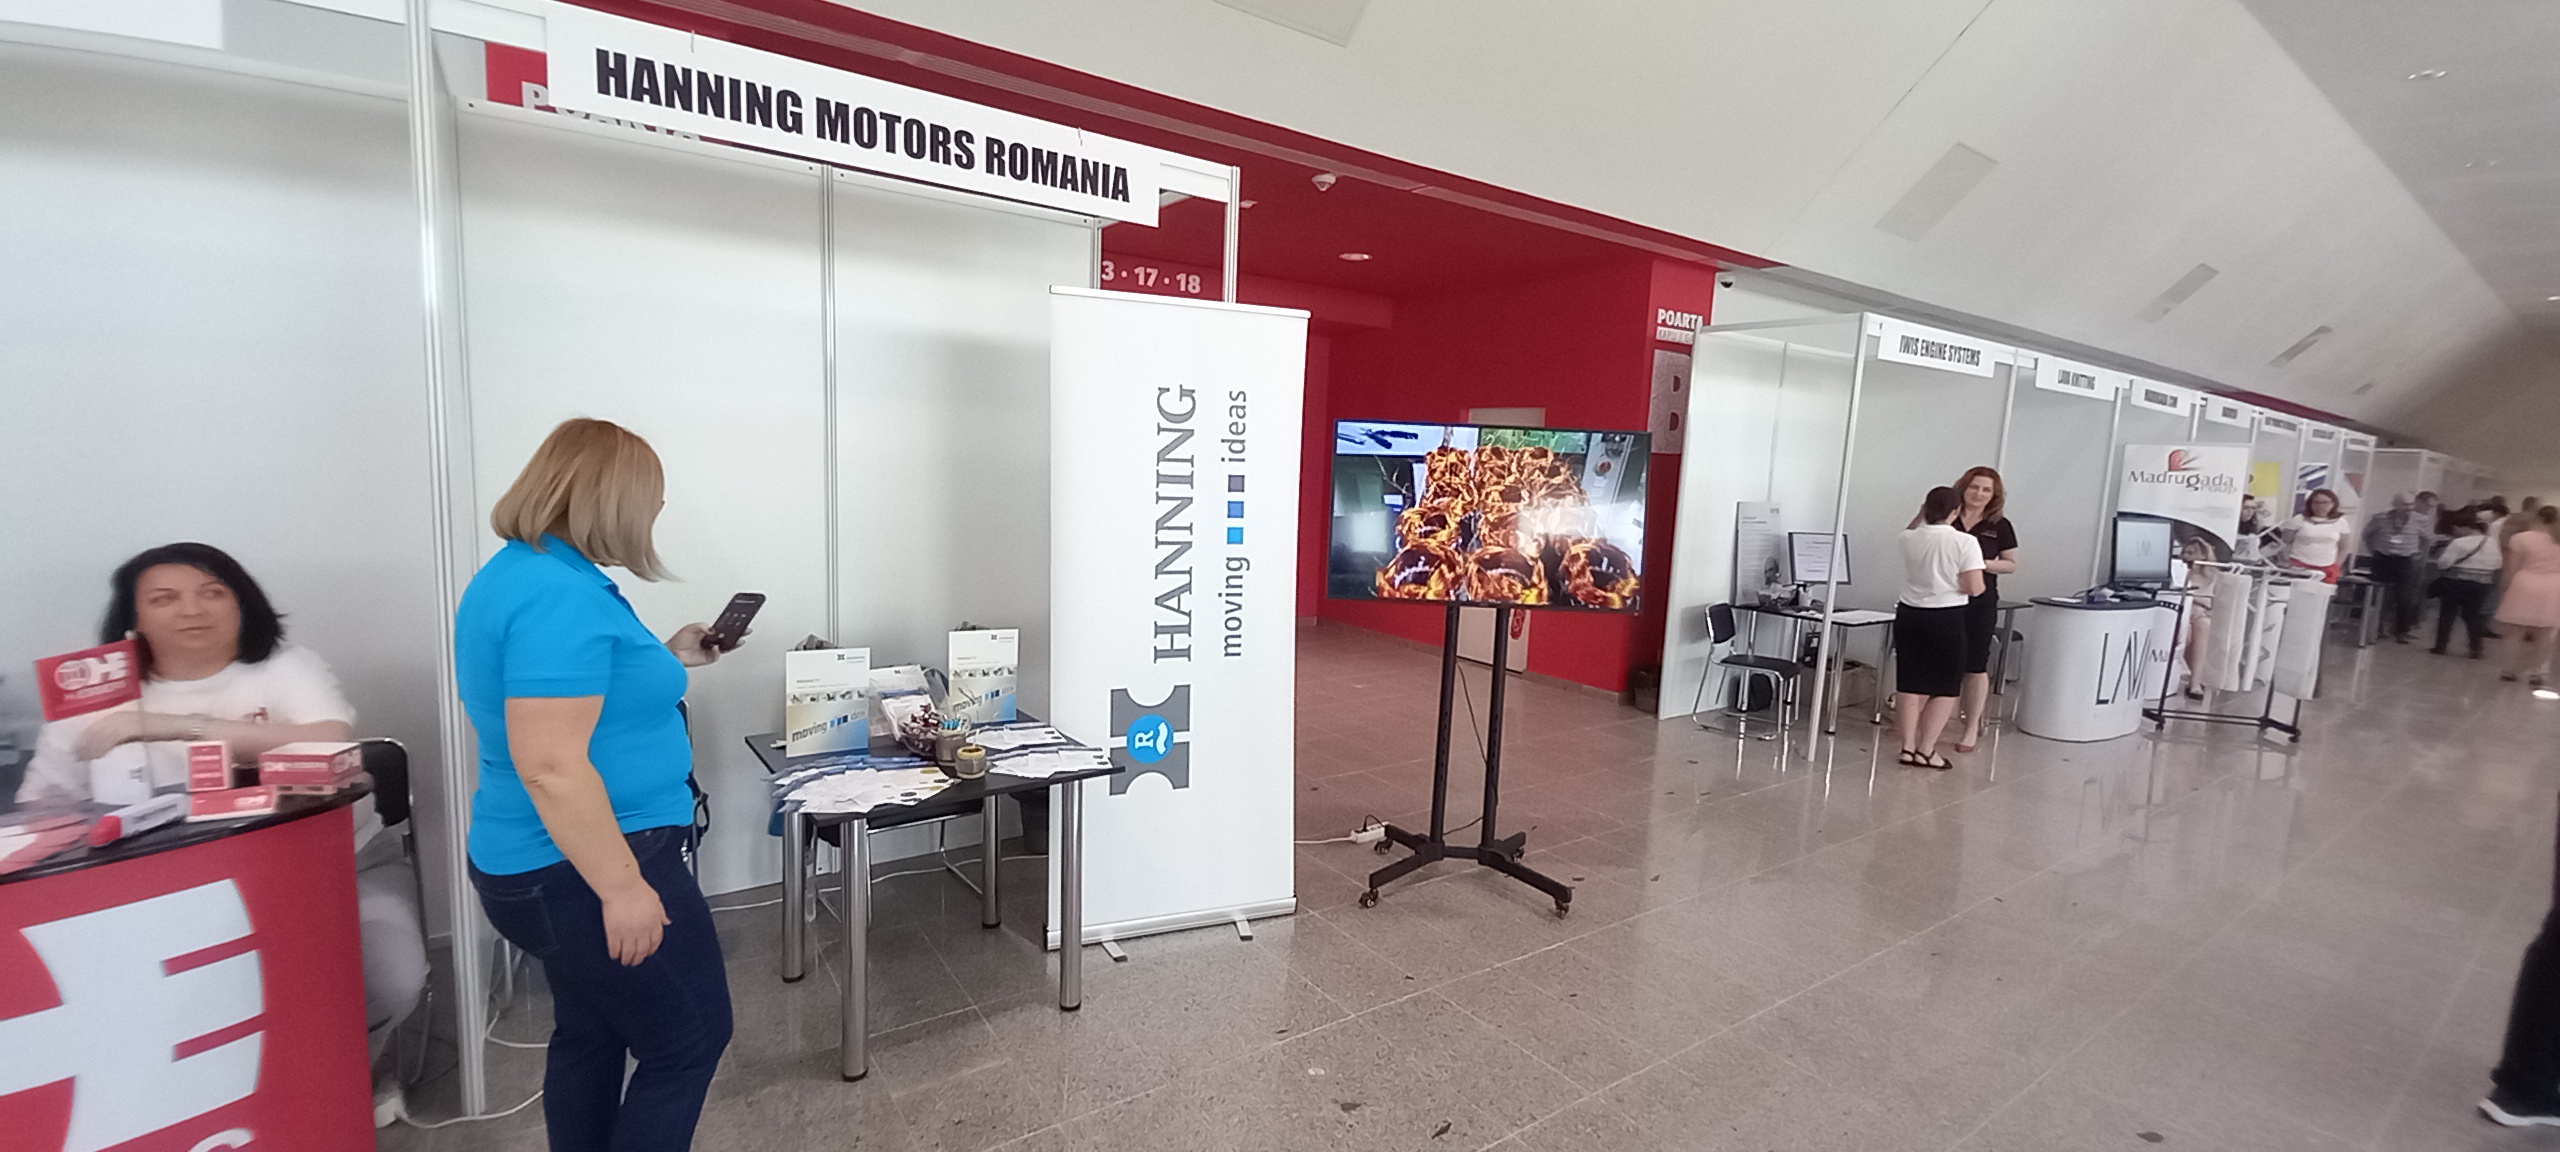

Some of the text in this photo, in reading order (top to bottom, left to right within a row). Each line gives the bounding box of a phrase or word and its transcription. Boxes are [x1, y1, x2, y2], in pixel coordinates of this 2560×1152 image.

[595, 47, 804, 135] HANNING
[815, 97, 975, 170] MOTORS
[985, 136, 1131, 203] ROMANIA
[1134, 266, 1159, 288] 17
[1176, 273, 1201, 294] 18
[1920, 339, 1948, 361] ENGINE
[1948, 345, 1981, 367] SYSTEMS
[2128, 470, 2235, 492] Madrugada
[1153, 384, 1197, 664] HANNING
[1218, 389, 1250, 658] moving ideas
[791, 721, 829, 743] moving
